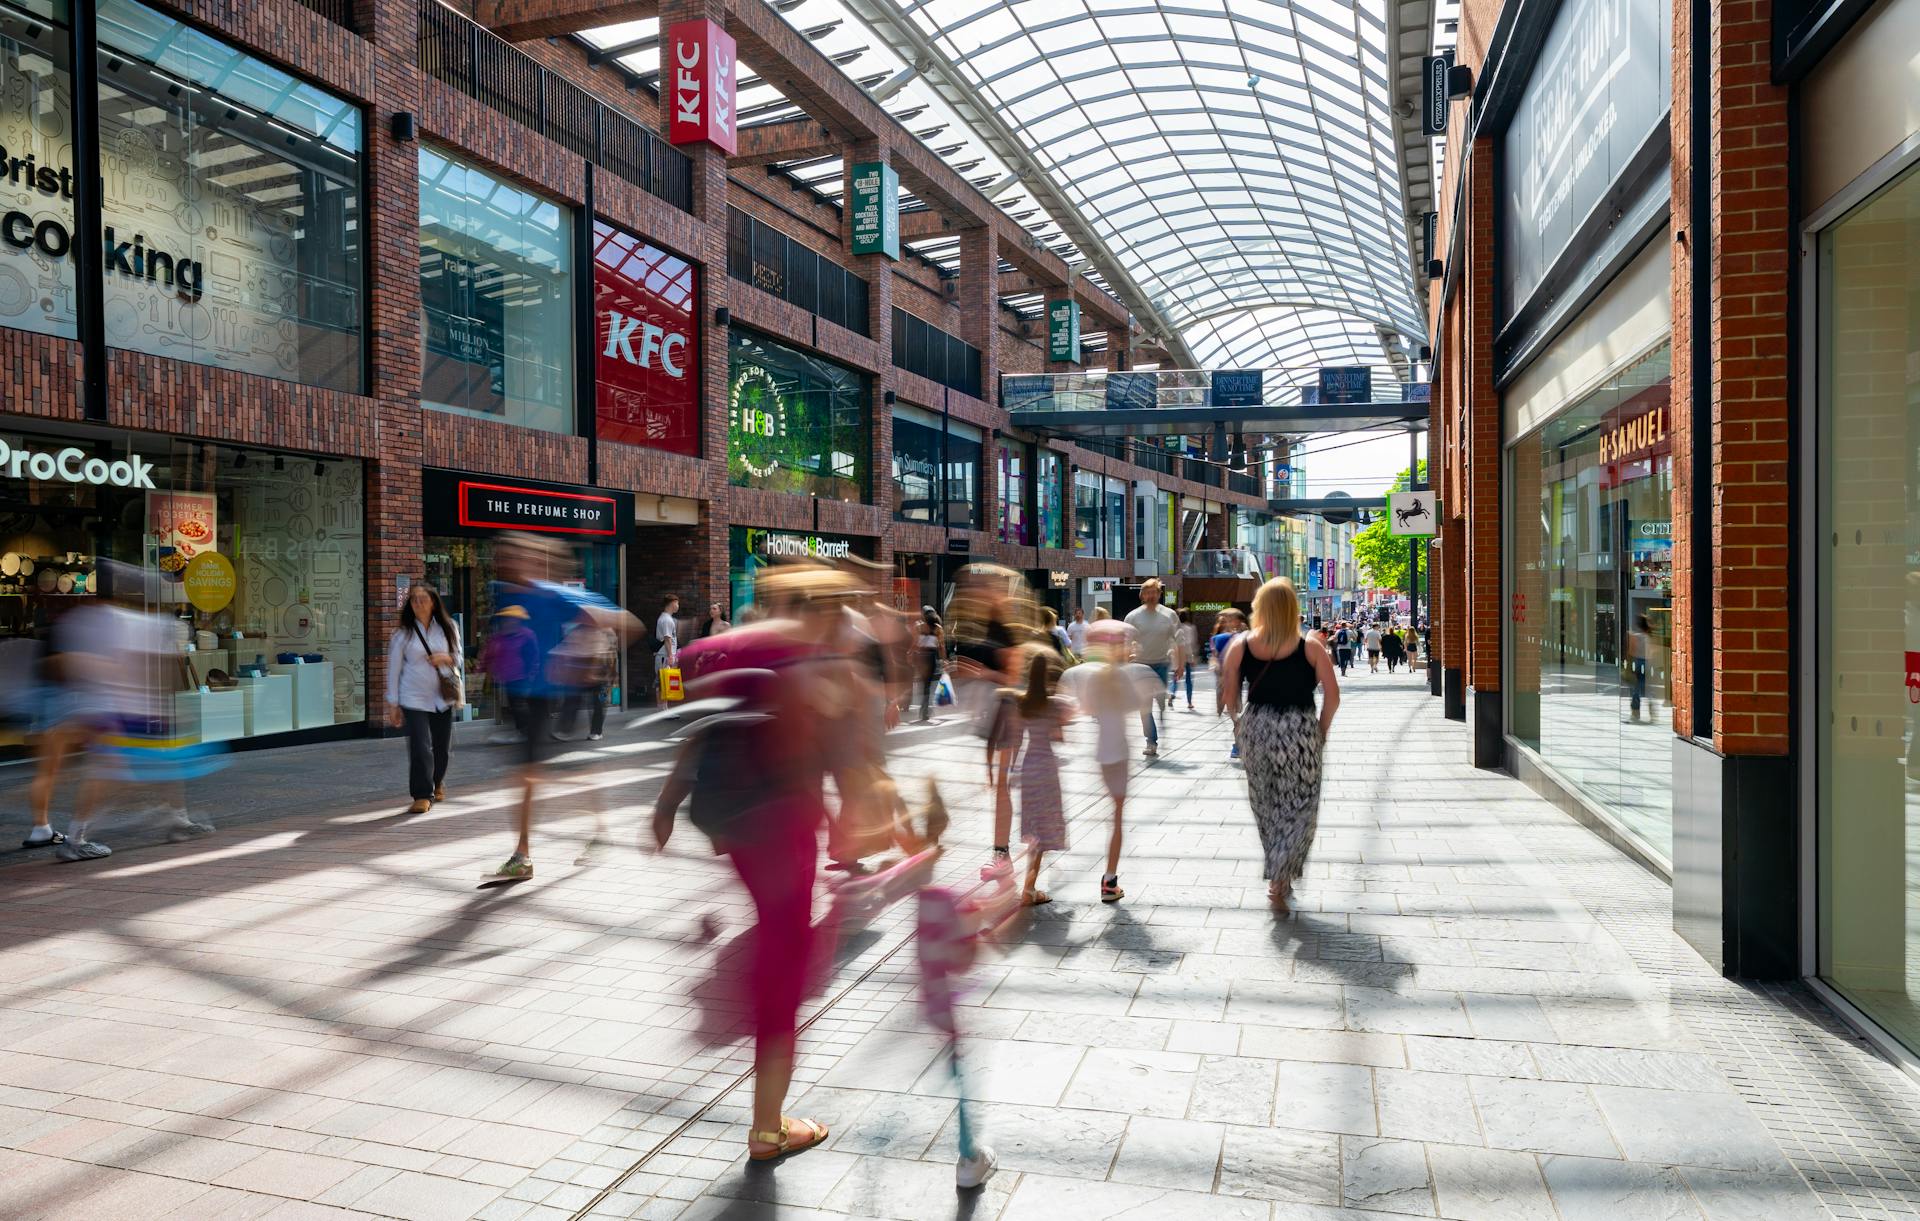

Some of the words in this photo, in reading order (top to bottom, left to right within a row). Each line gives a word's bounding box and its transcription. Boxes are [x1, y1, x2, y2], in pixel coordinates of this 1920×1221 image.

[677, 42, 700, 126] KFC
[715, 44, 730, 136] KFC
[1535, 45, 1576, 184] ESCAPE
[2, 210, 203, 304] coking
[603, 309, 687, 378] KFC
[742, 407, 774, 437] H&B
[904, 453, 934, 476] Summers
[487, 500, 510, 513] THE
[517, 502, 567, 518] PERFUME
[573, 508, 601, 521] SHOP
[188, 577, 232, 587] SAVINGS
[1195, 602, 1225, 611] scribbler
